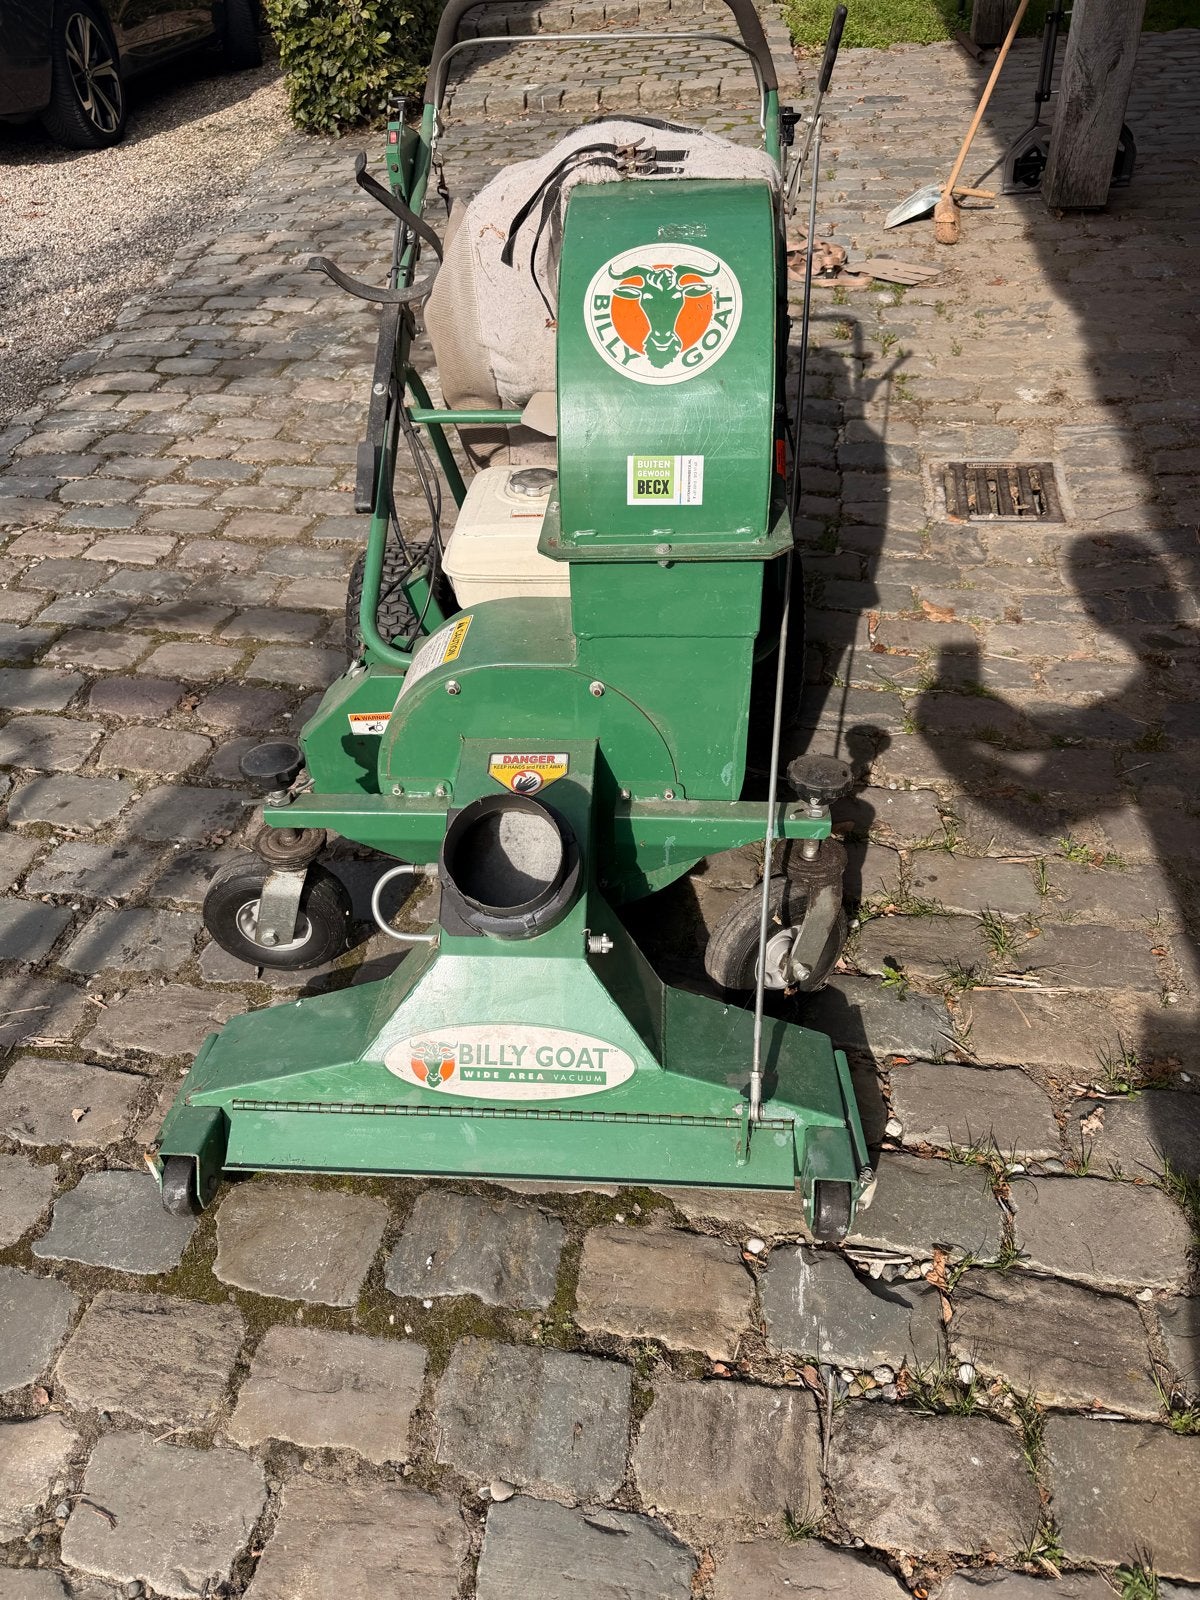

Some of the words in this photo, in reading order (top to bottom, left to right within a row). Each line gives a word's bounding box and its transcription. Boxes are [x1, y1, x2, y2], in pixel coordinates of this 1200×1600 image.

[593, 294, 641, 366] BILLY
[681, 290, 733, 367] GOAT
[637, 460, 671, 468] BUITEN
[637, 479, 670, 495] BECX
[502, 755, 556, 764] DANGER
[458, 1043, 528, 1066] BILLY
[535, 1045, 610, 1069] GOAT
[463, 1070, 499, 1079] WIDE
[508, 1072, 545, 1080] AREA
[552, 1073, 602, 1082] VACUUM
